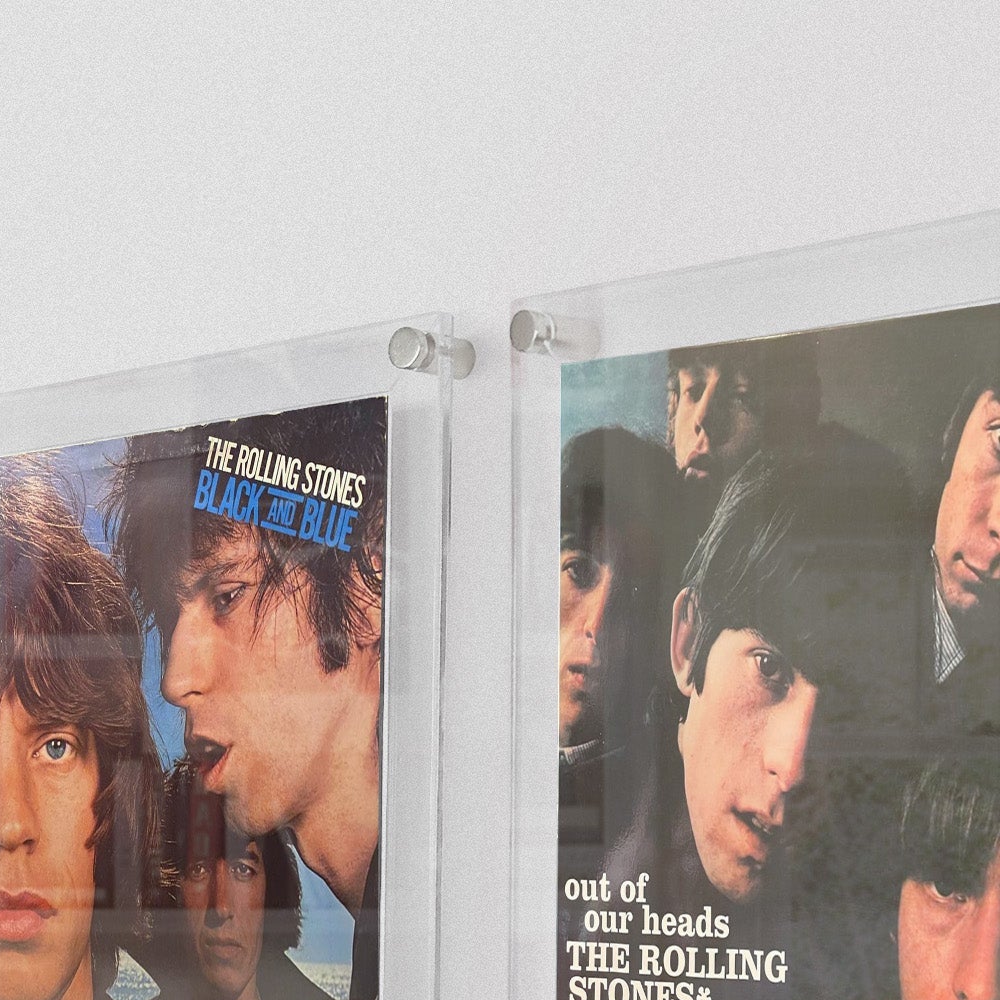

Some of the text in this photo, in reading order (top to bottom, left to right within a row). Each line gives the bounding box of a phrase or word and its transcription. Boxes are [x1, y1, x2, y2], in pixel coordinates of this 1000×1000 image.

[206, 436, 366, 509] THE ROLLING STONES
[194, 469, 358, 552] BLACK AND BLUE
[564, 872, 649, 903] out of
[584, 905, 730, 939] our heads
[566, 940, 788, 983] THE ROLLING
